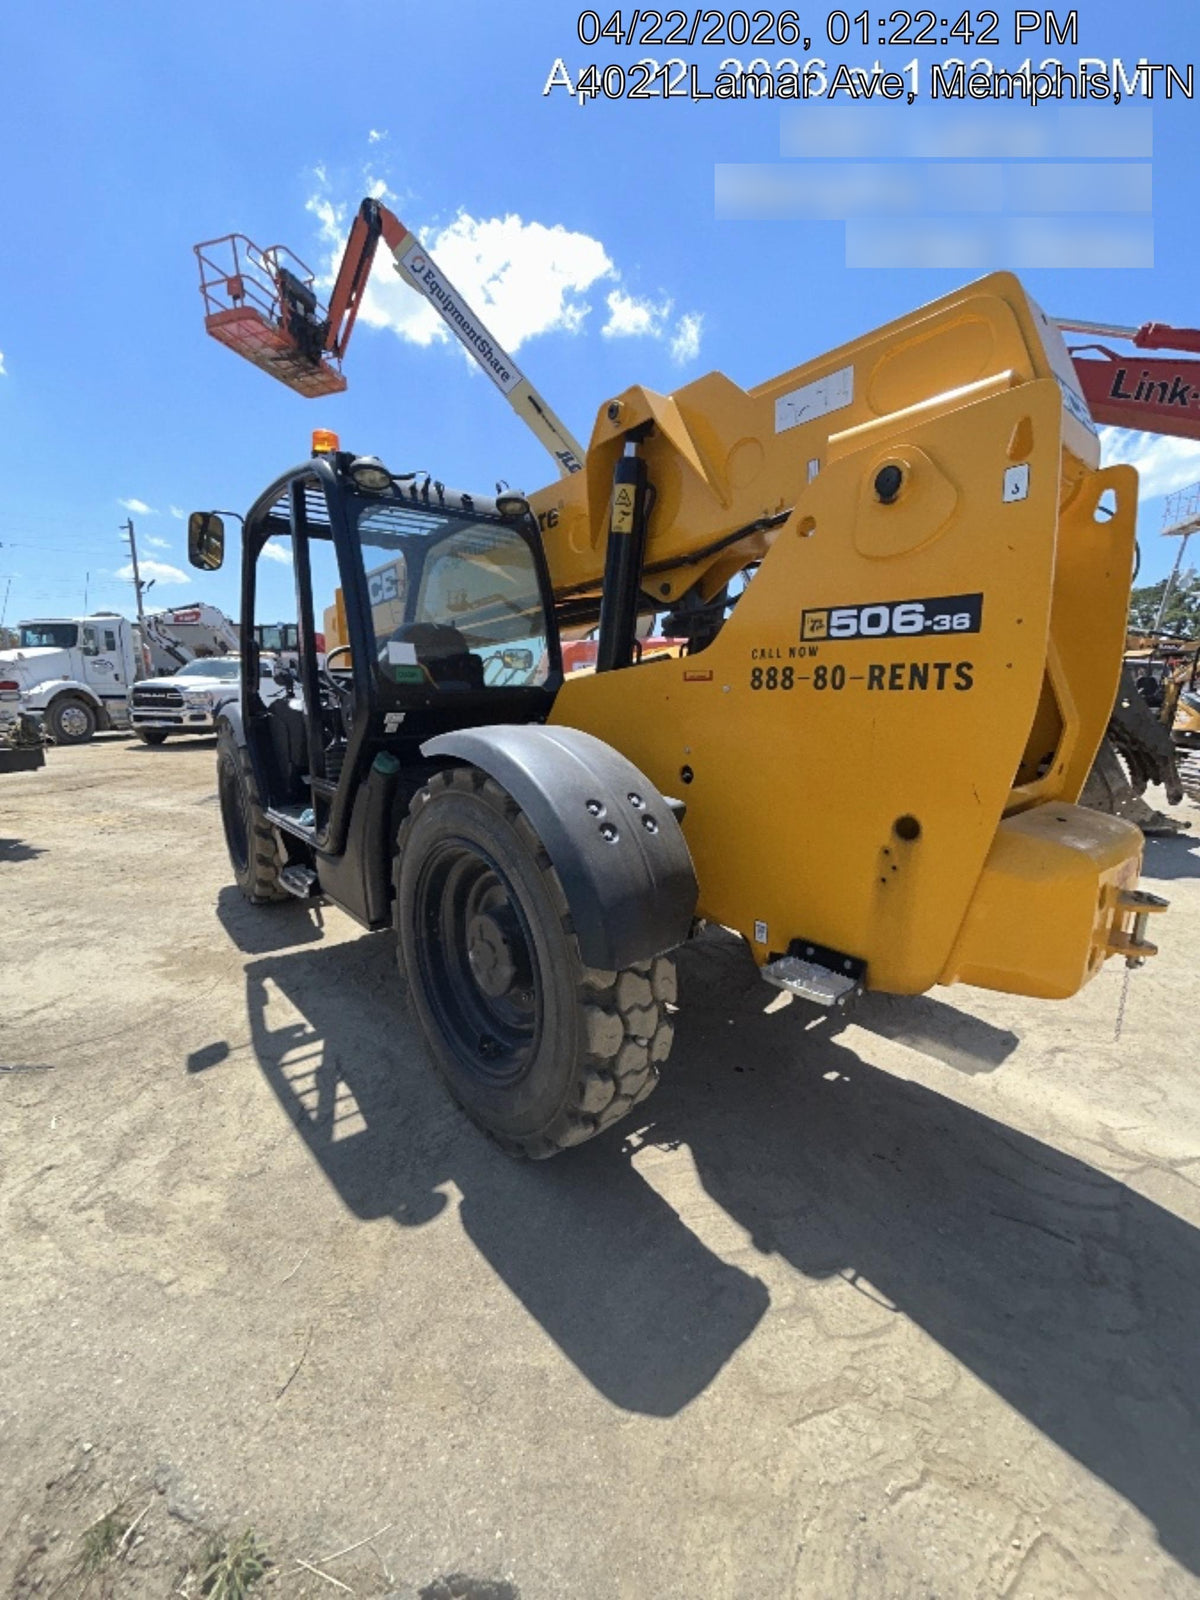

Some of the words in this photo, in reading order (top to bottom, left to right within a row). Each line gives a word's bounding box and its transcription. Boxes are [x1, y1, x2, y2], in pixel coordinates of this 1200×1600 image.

[422, 270, 510, 383] EquipmentShare
[829, 603, 970, 637] 506-36
[751, 648, 781, 660] CALL
[788, 645, 818, 659] NOW
[750, 661, 974, 691] 888-80-RENTS
